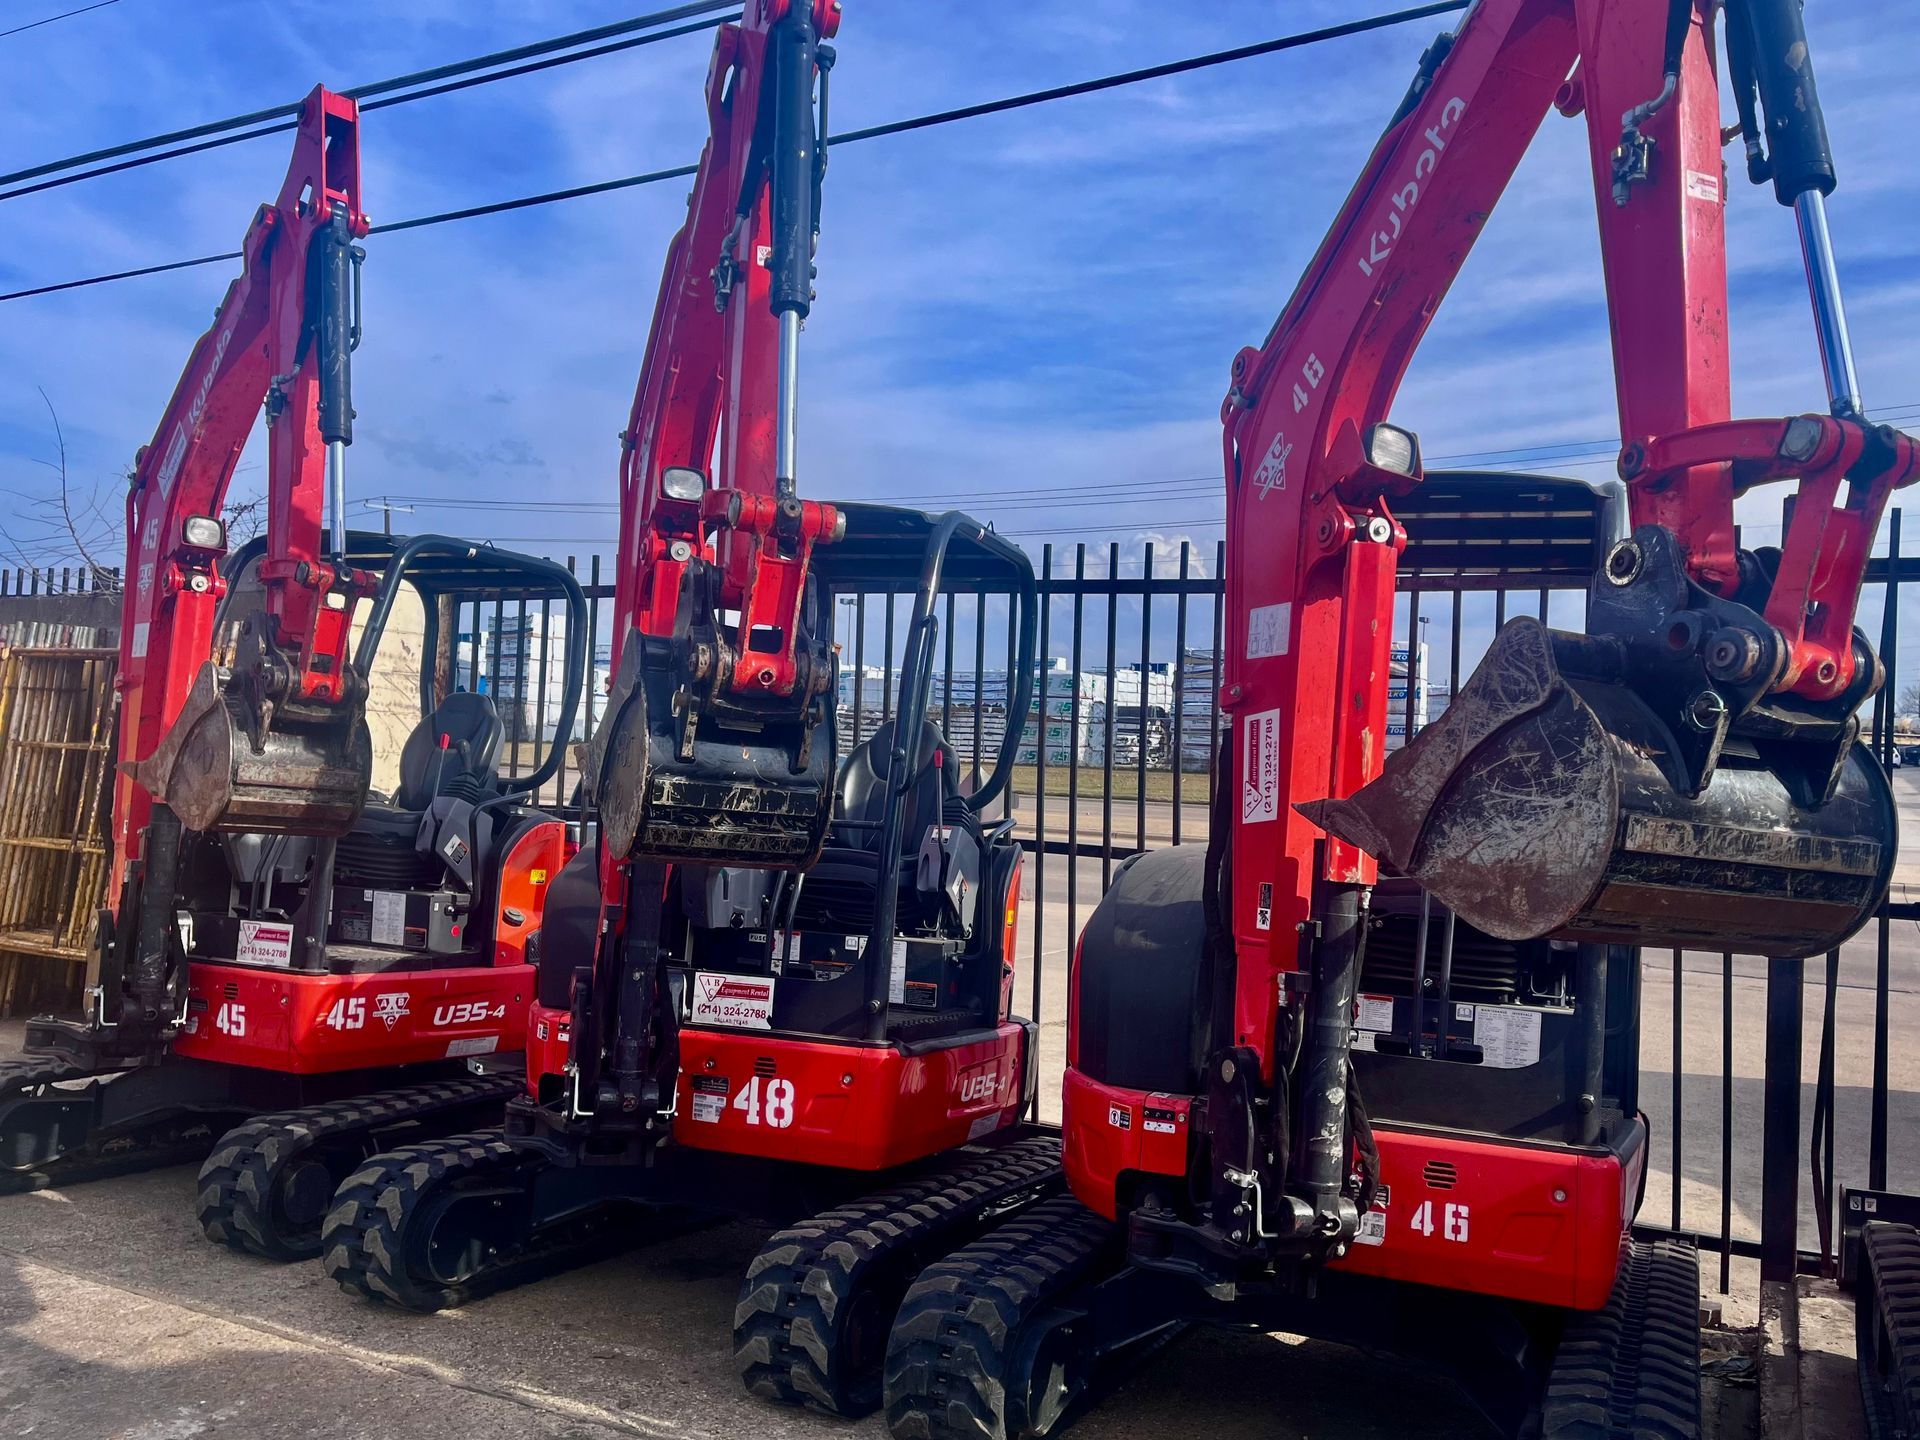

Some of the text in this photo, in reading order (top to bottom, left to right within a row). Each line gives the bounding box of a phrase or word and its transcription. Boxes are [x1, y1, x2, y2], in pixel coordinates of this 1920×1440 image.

[1358, 96, 1466, 277] Kubota
[188, 329, 231, 425] Kubota
[1293, 352, 1325, 414] 46
[142, 518, 158, 550] 45
[1391, 652, 1408, 661] LKO
[1388, 690, 1405, 698] LKO
[1264, 718, 1273, 814] (214) 324-2788
[240, 945, 257, 956] (214)
[720, 986, 769, 998] Equipment Rental
[215, 1002, 246, 1037] 45
[326, 998, 365, 1031] 45
[433, 1001, 505, 1026] U35-4
[697, 1003, 767, 1020] (214) 324-2788
[733, 1075, 795, 1129] 48
[960, 1072, 1006, 1102] U35-4
[1410, 1200, 1470, 1243] 46
